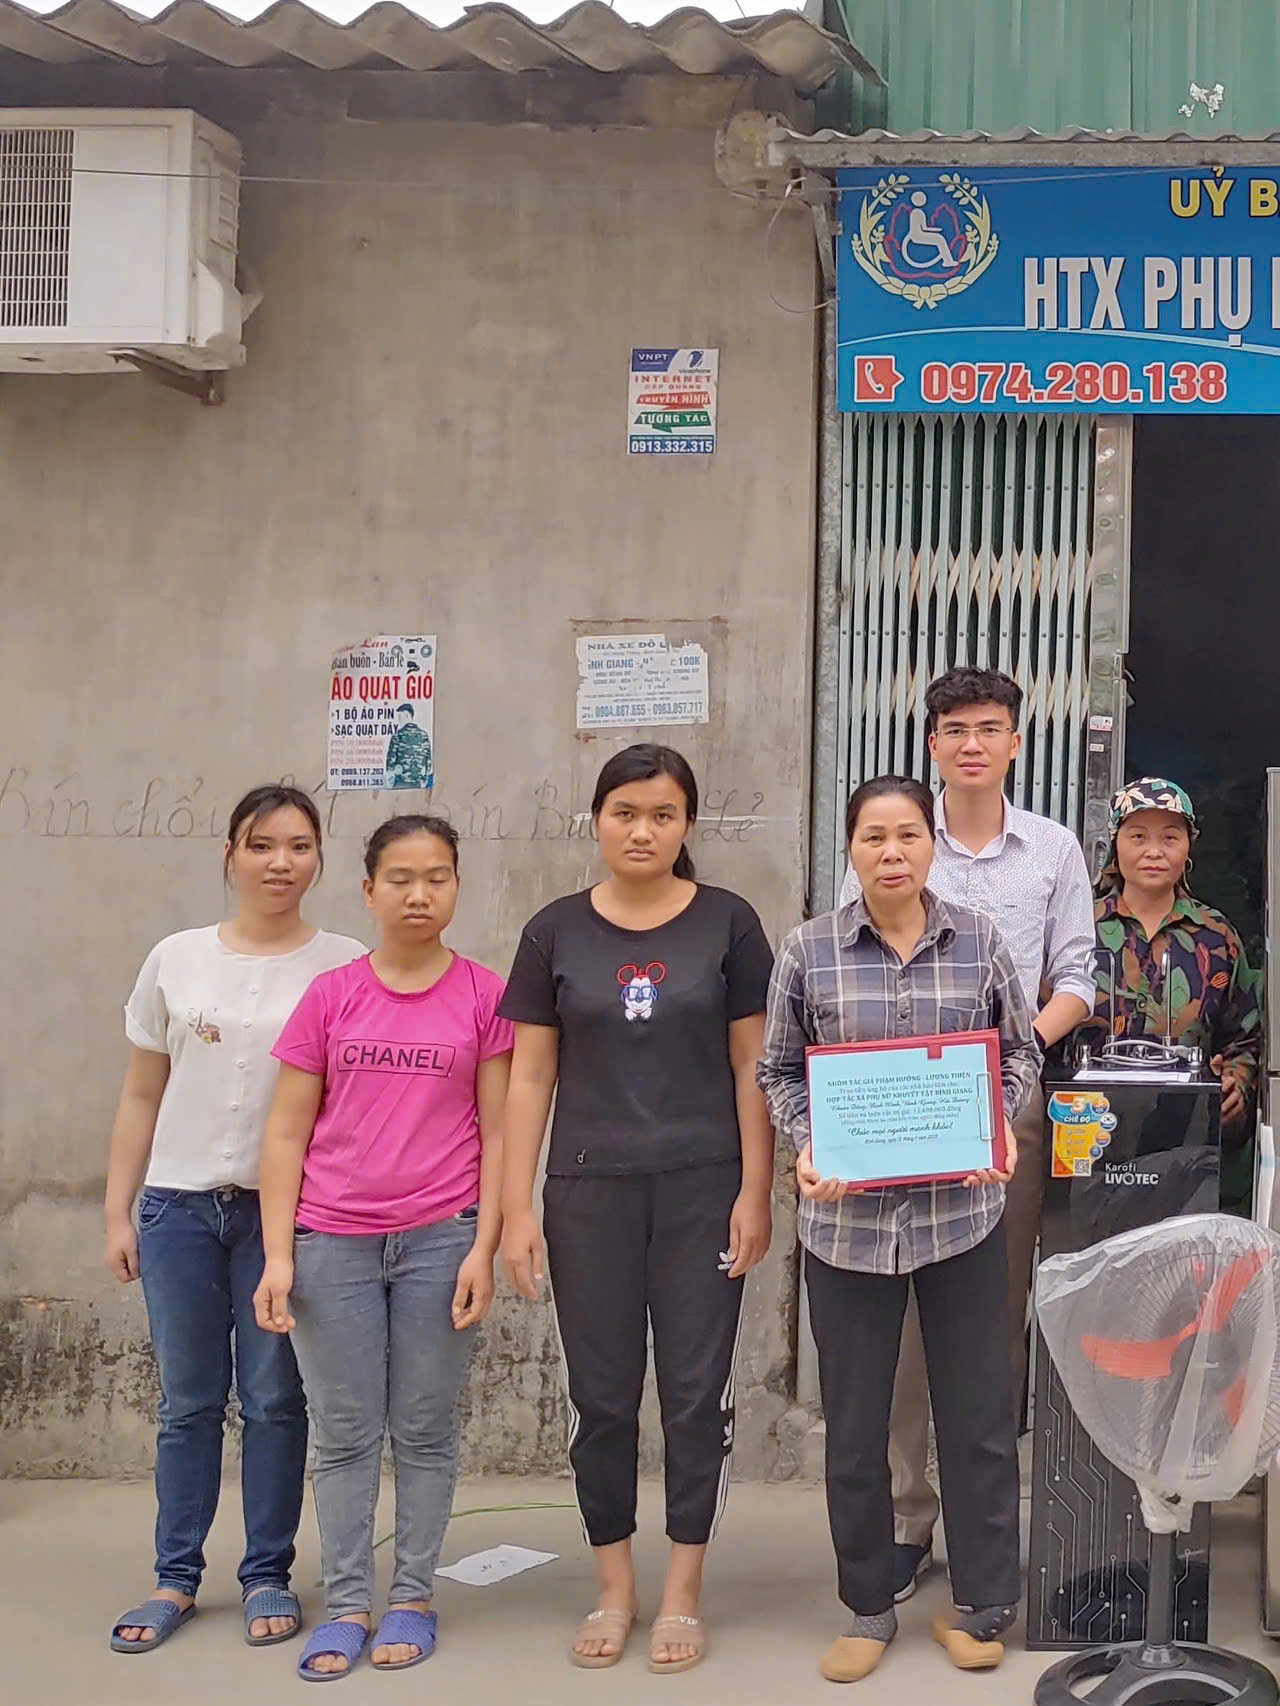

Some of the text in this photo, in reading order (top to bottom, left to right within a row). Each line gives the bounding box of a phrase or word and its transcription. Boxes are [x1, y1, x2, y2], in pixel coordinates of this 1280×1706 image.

[1170, 166, 1235, 217] UỶ
[1024, 257, 1127, 331] HTX
[1144, 257, 1252, 347] PHỤ
[638, 353, 669, 361] VNPT
[923, 363, 1226, 402] 0974.280.138
[631, 441, 713, 453] 0913.332.315
[350, 651, 371, 668] buôn
[379, 651, 395, 668] Bán
[606, 659, 634, 669] GIANG
[332, 670, 433, 706] ÁO QUẠT GIÓ
[344, 708, 358, 723] BỘ
[361, 707, 374, 720] ÁO
[377, 709, 395, 719] PIN
[335, 724, 353, 739] SẠC
[356, 724, 378, 739] QUẠT
[343, 1045, 444, 1070] CHANEL
[1071, 1096, 1086, 1113] 3
[1105, 1163, 1137, 1172] Karofi
[1105, 1172, 1160, 1185] LIVOTEC
